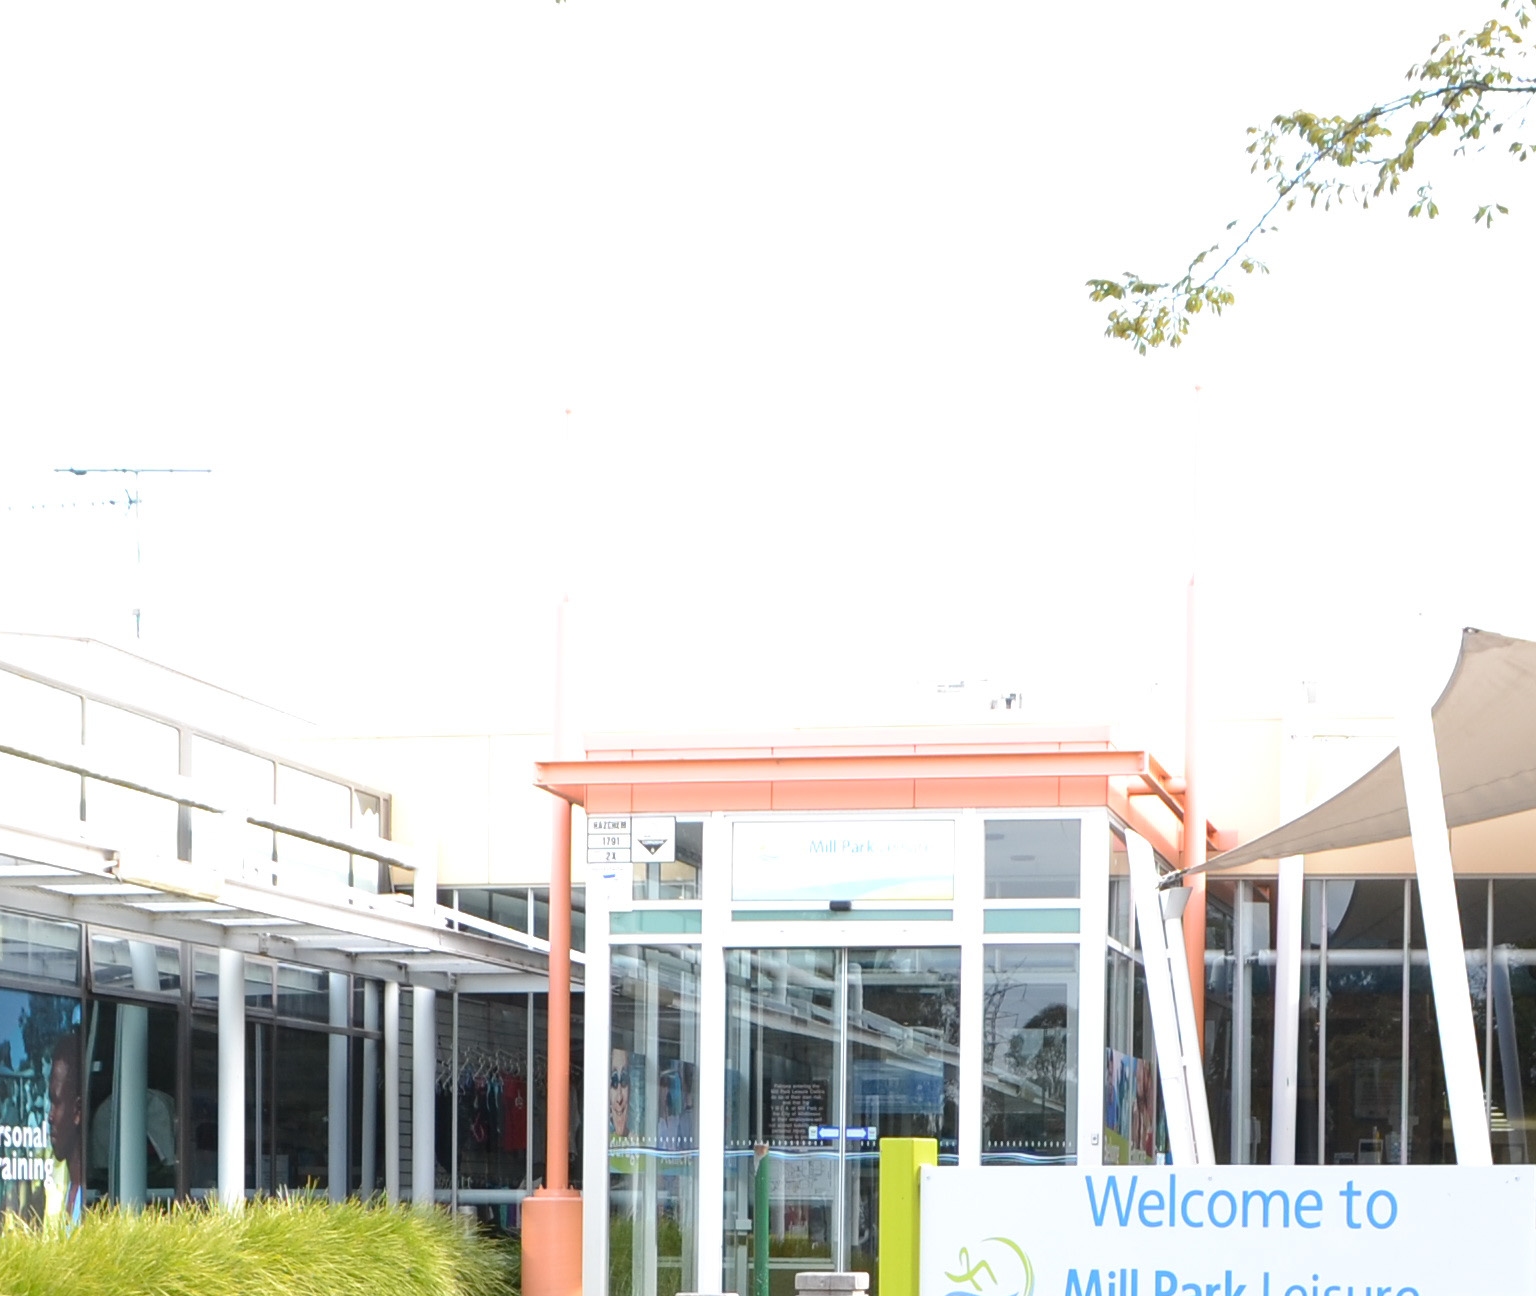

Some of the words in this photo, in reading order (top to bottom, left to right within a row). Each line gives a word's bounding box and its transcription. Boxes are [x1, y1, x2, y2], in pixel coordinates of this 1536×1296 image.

[602, 837, 620, 846] 1791
[809, 839, 836, 853] Mill
[842, 839, 873, 853] Park
[1085, 1173, 1323, 1229] Welcome
[1339, 1180, 1398, 1229] to
